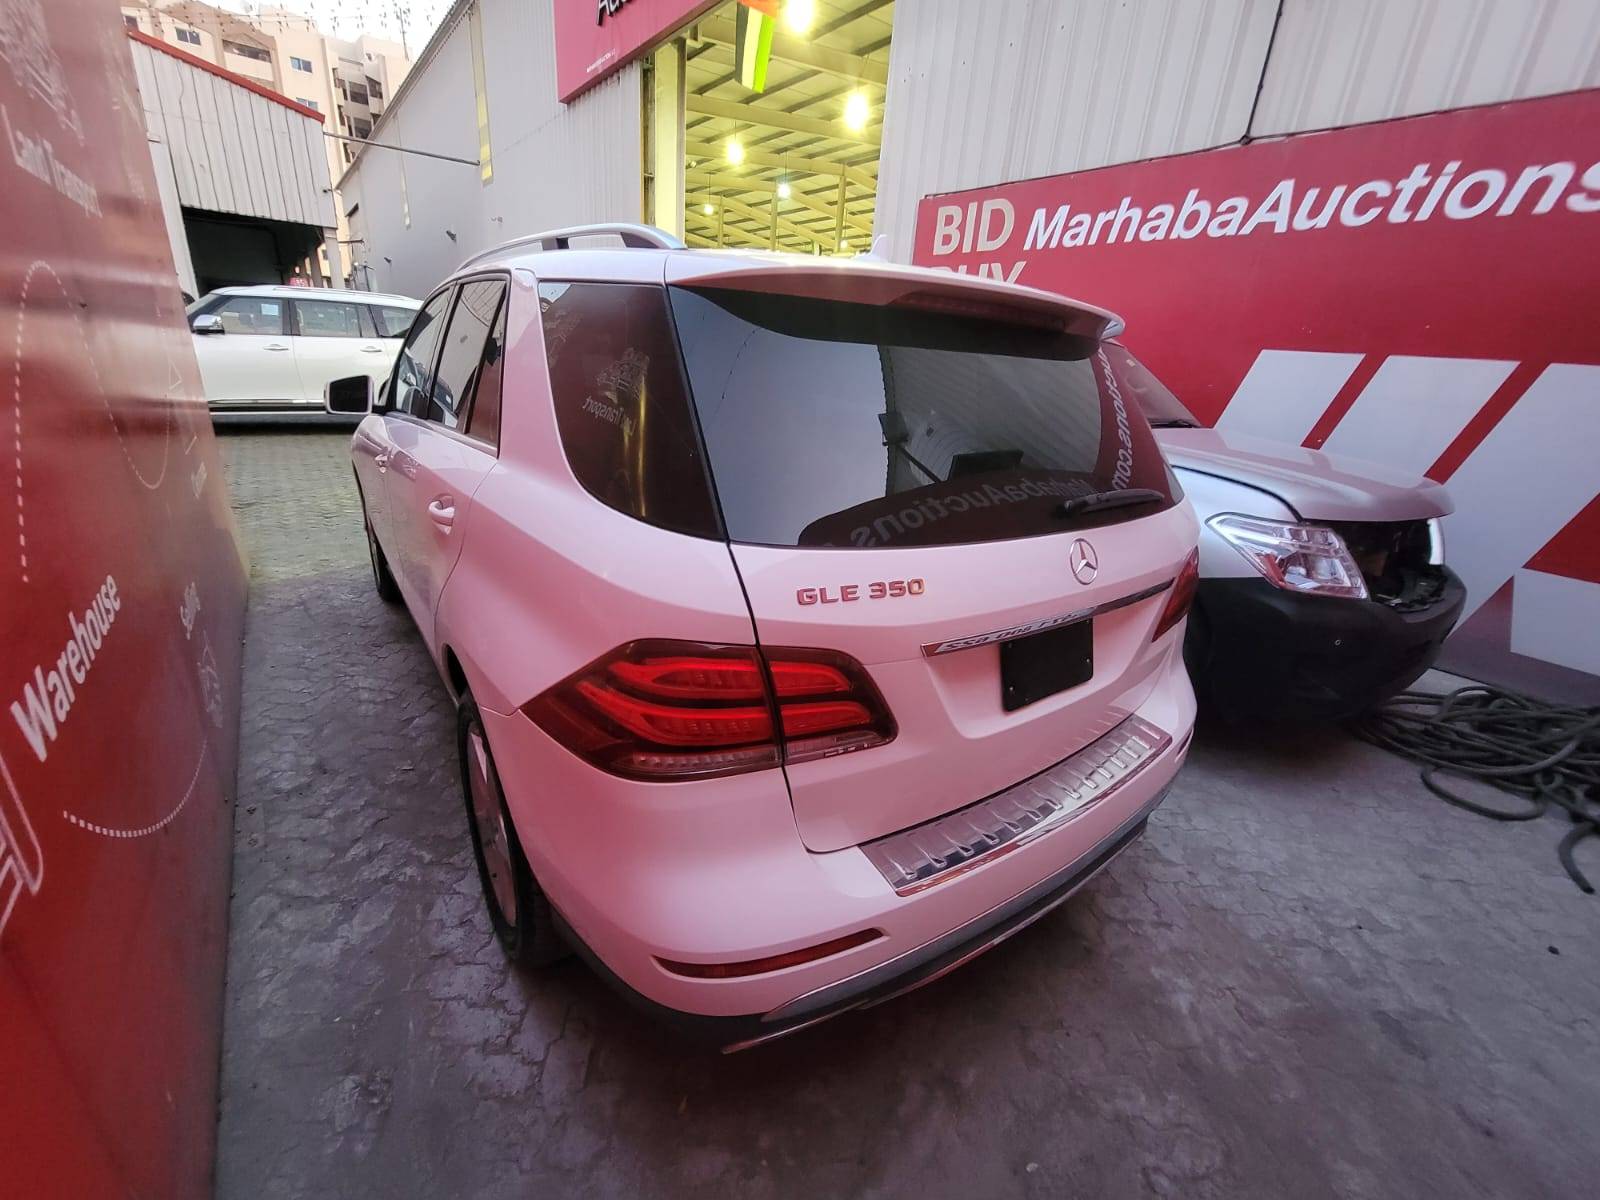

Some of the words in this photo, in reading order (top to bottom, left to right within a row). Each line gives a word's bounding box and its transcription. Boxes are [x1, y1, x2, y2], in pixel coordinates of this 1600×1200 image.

[933, 198, 1015, 256] BID
[796, 585, 861, 606] GLE
[868, 578, 925, 600] 350
[10, 574, 121, 763] Warehouse
